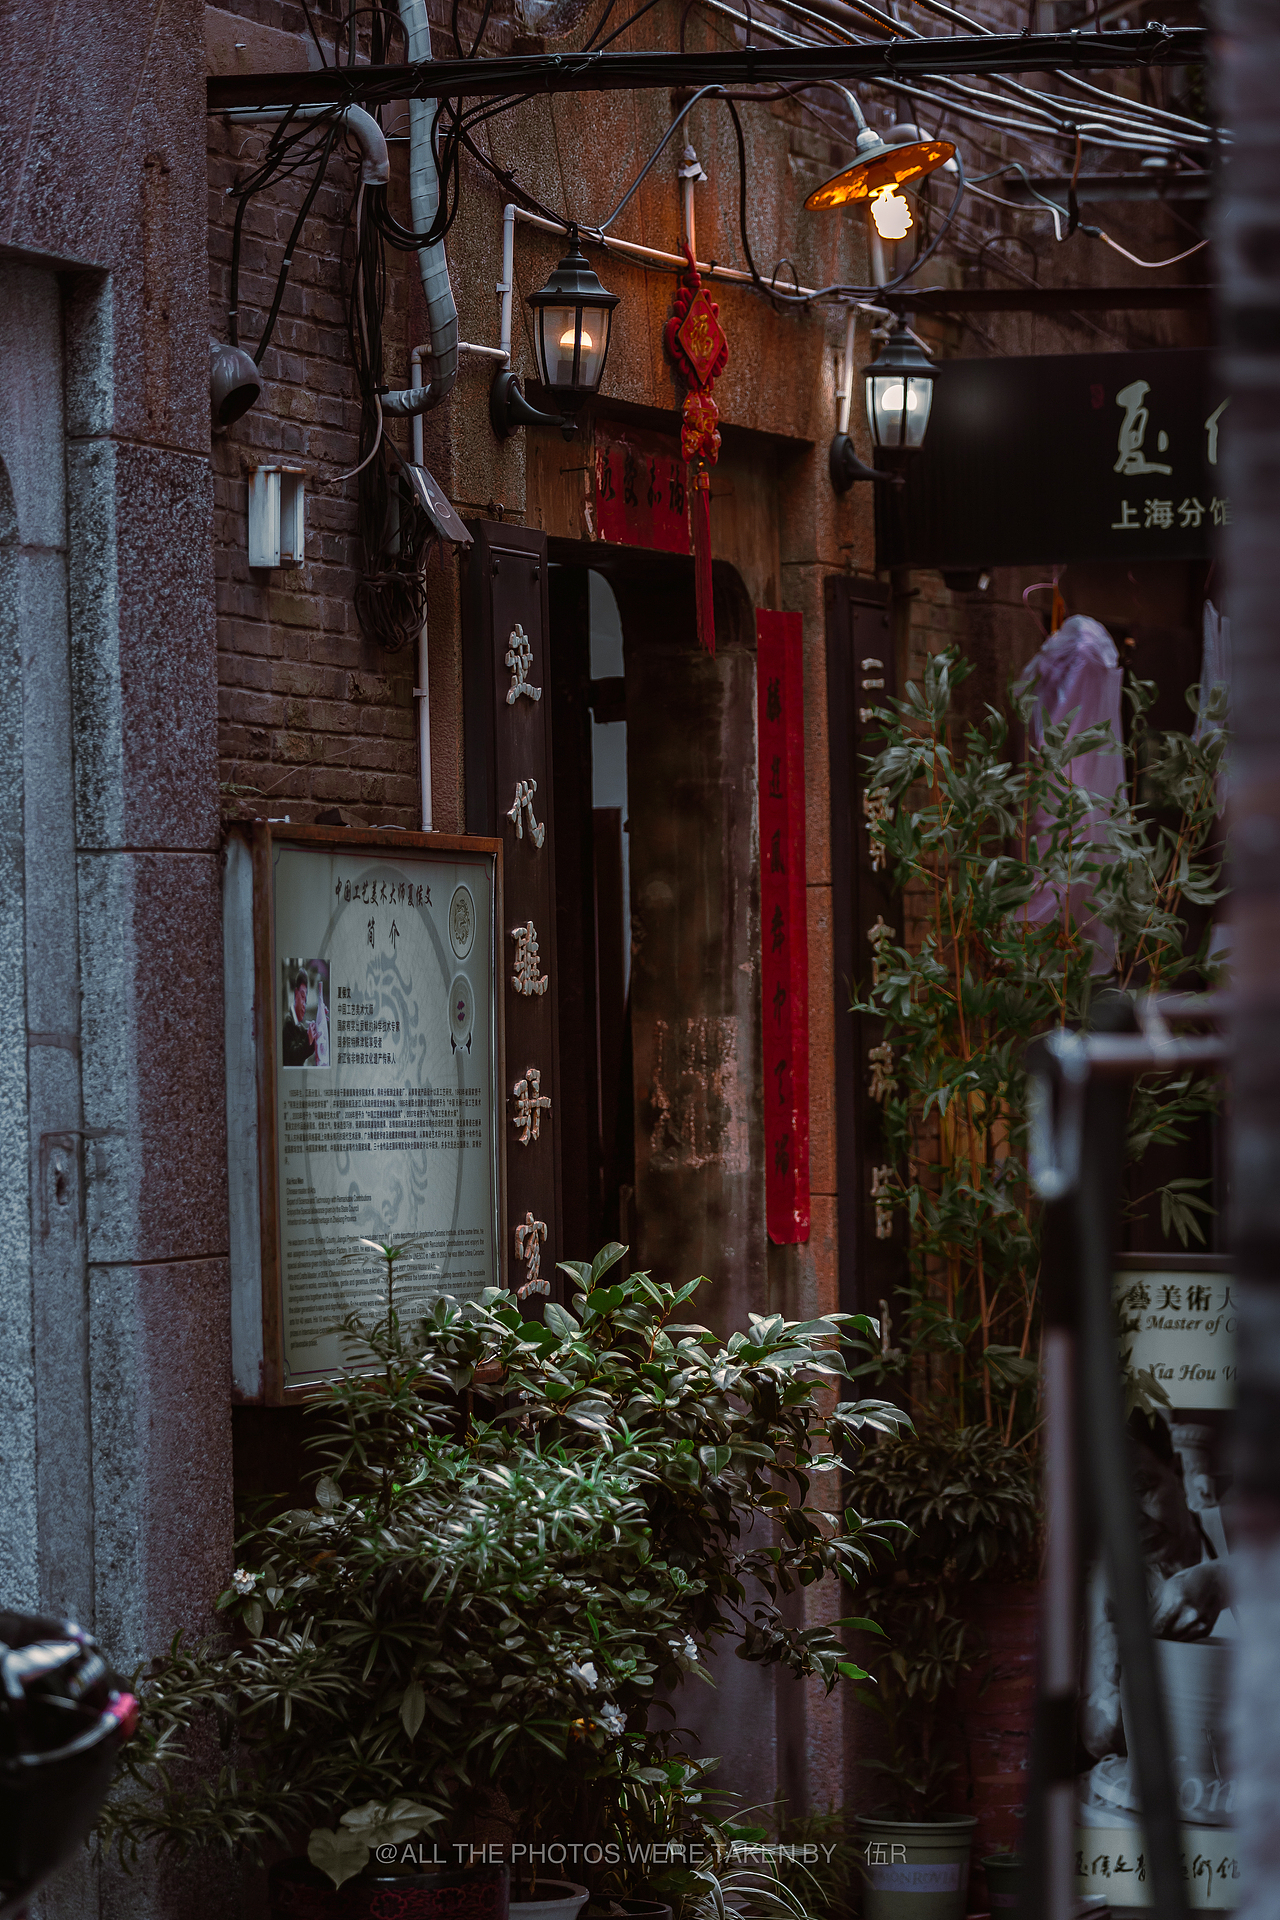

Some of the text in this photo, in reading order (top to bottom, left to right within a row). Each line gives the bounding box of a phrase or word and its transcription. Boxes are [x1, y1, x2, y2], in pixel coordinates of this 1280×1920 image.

[335, 876, 433, 908] 中国工艺美术大师夏侯文
[1145, 1315, 1238, 1336] Master of C
[1179, 1364, 1217, 1381] Hou
